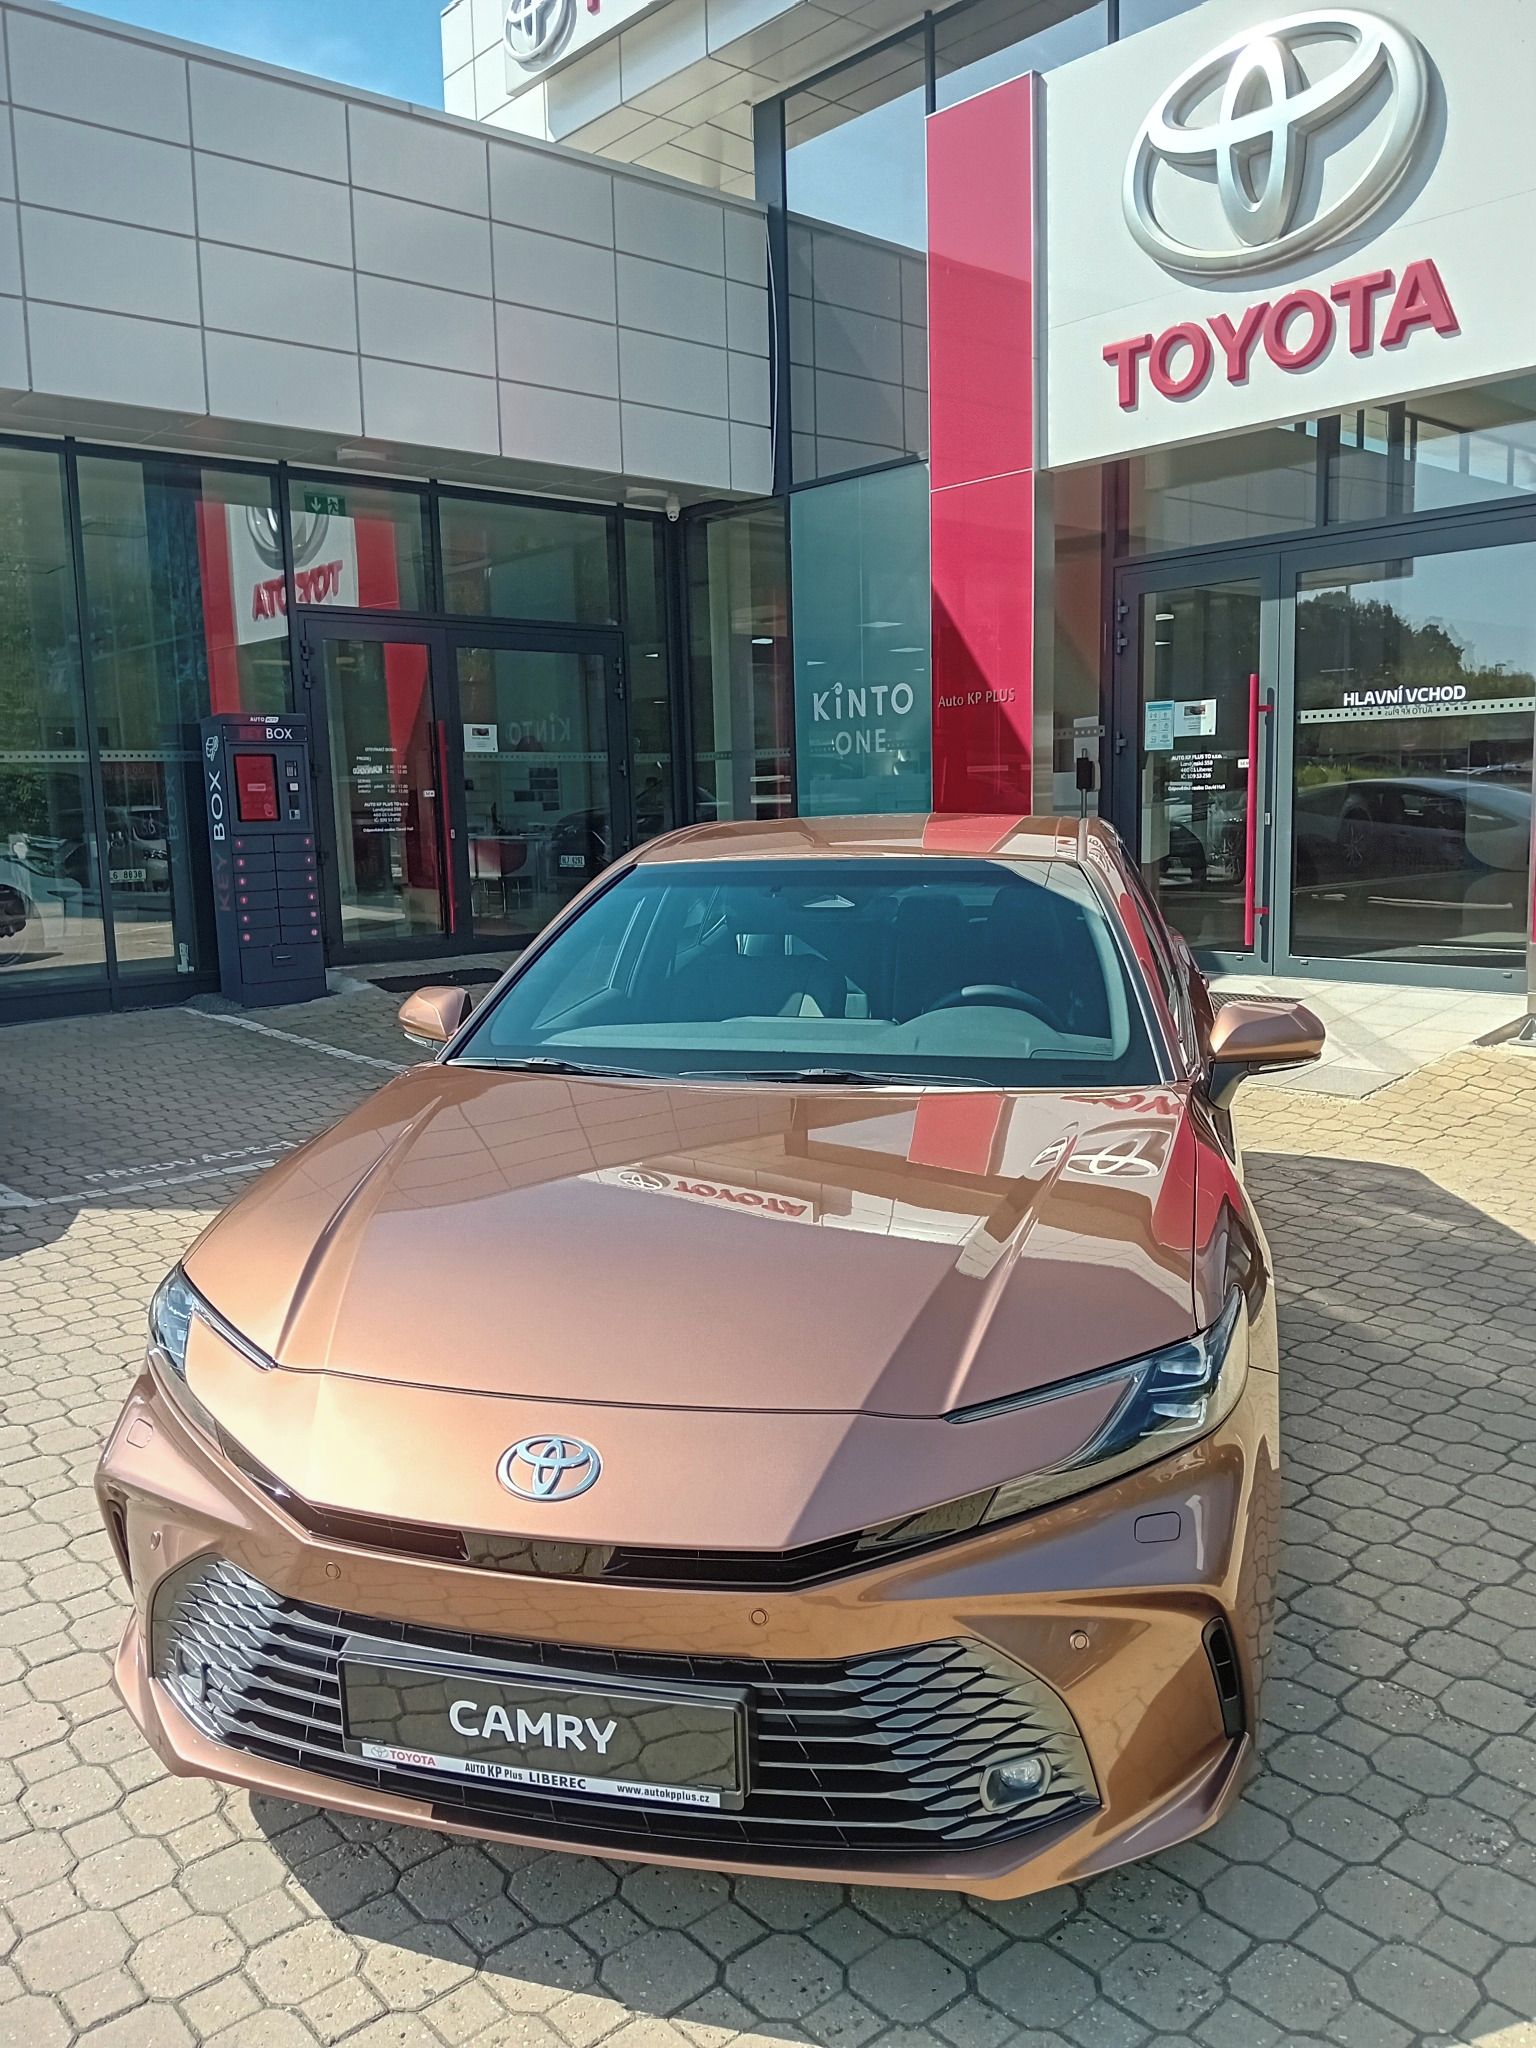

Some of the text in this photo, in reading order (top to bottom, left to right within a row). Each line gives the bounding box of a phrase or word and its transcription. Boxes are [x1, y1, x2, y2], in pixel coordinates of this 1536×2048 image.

[1102, 258, 1460, 409] TOYOTA
[938, 687, 1016, 709] Auto KP PLUS
[1343, 685, 1403, 707] HLAVNÍ
[1406, 685, 1467, 703] VCHOD
[266, 728, 293, 740] BOX
[835, 728, 887, 755] ONE
[208, 770, 226, 841] BOX
[449, 1700, 617, 1755] CAMRY
[388, 1750, 436, 1768] TOYOTA
[465, 1761, 587, 1791] AUTO KP Plus LIBEREC
[616, 1783, 711, 1804] www.autokpplus.cz
